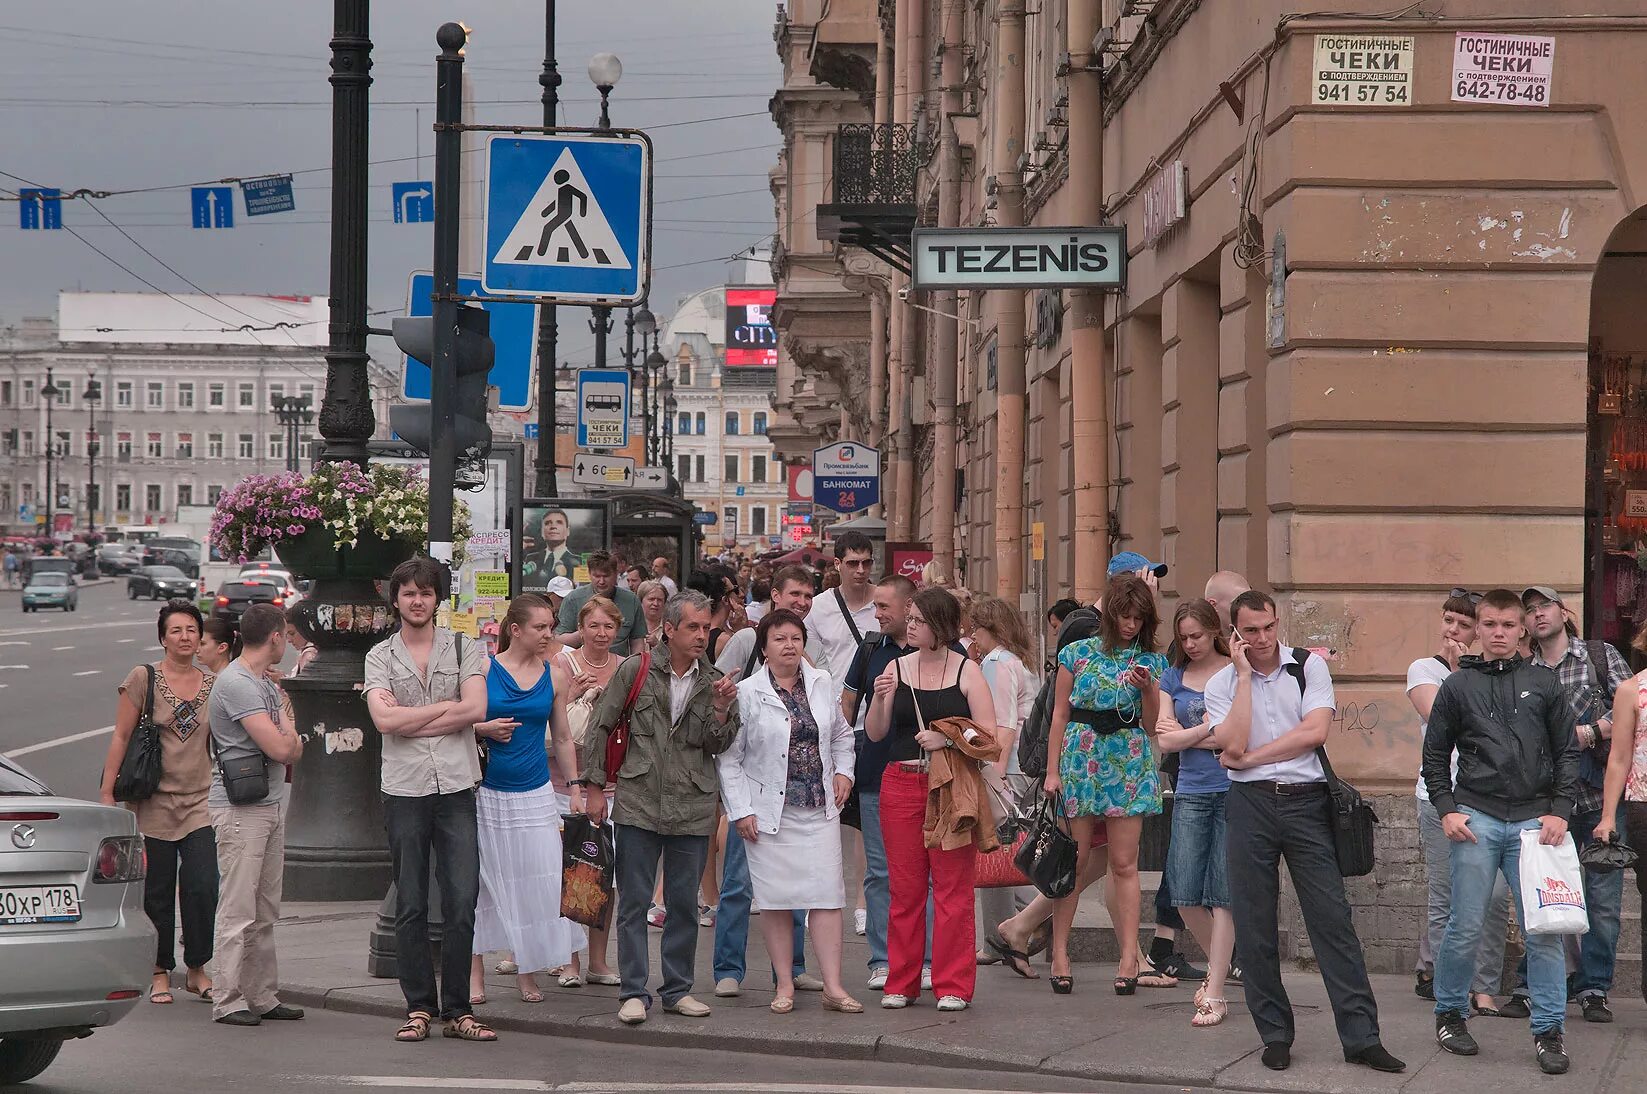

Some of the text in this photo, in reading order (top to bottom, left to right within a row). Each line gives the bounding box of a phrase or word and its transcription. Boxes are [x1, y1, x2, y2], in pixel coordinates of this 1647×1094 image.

[1321, 38, 1410, 51] ГОСТИНИЧНЫЕ
[1460, 38, 1550, 57] ГОСТИНИЧНЫЕ
[1330, 52, 1400, 70] ЧЕКИ
[1473, 55, 1532, 73] ЧЕКИ
[1321, 72, 1406, 82] С ПОДТВЕРЖДЕНИЕМ
[1466, 72, 1547, 83] подтверждением
[1318, 84, 1408, 103] 941 57 54
[1457, 80, 1545, 102] 642-78-48
[592, 424, 619, 432] ЧЕКИ
[588, 436, 622, 444] 941 57 54
[822, 480, 871, 489] БАНКОМАТ
[839, 491, 855, 501] 24
[472, 531, 509, 539] КСПРЕСС
[470, 537, 503, 545] КРЕДИТ
[45, 888, 73, 908] 178
